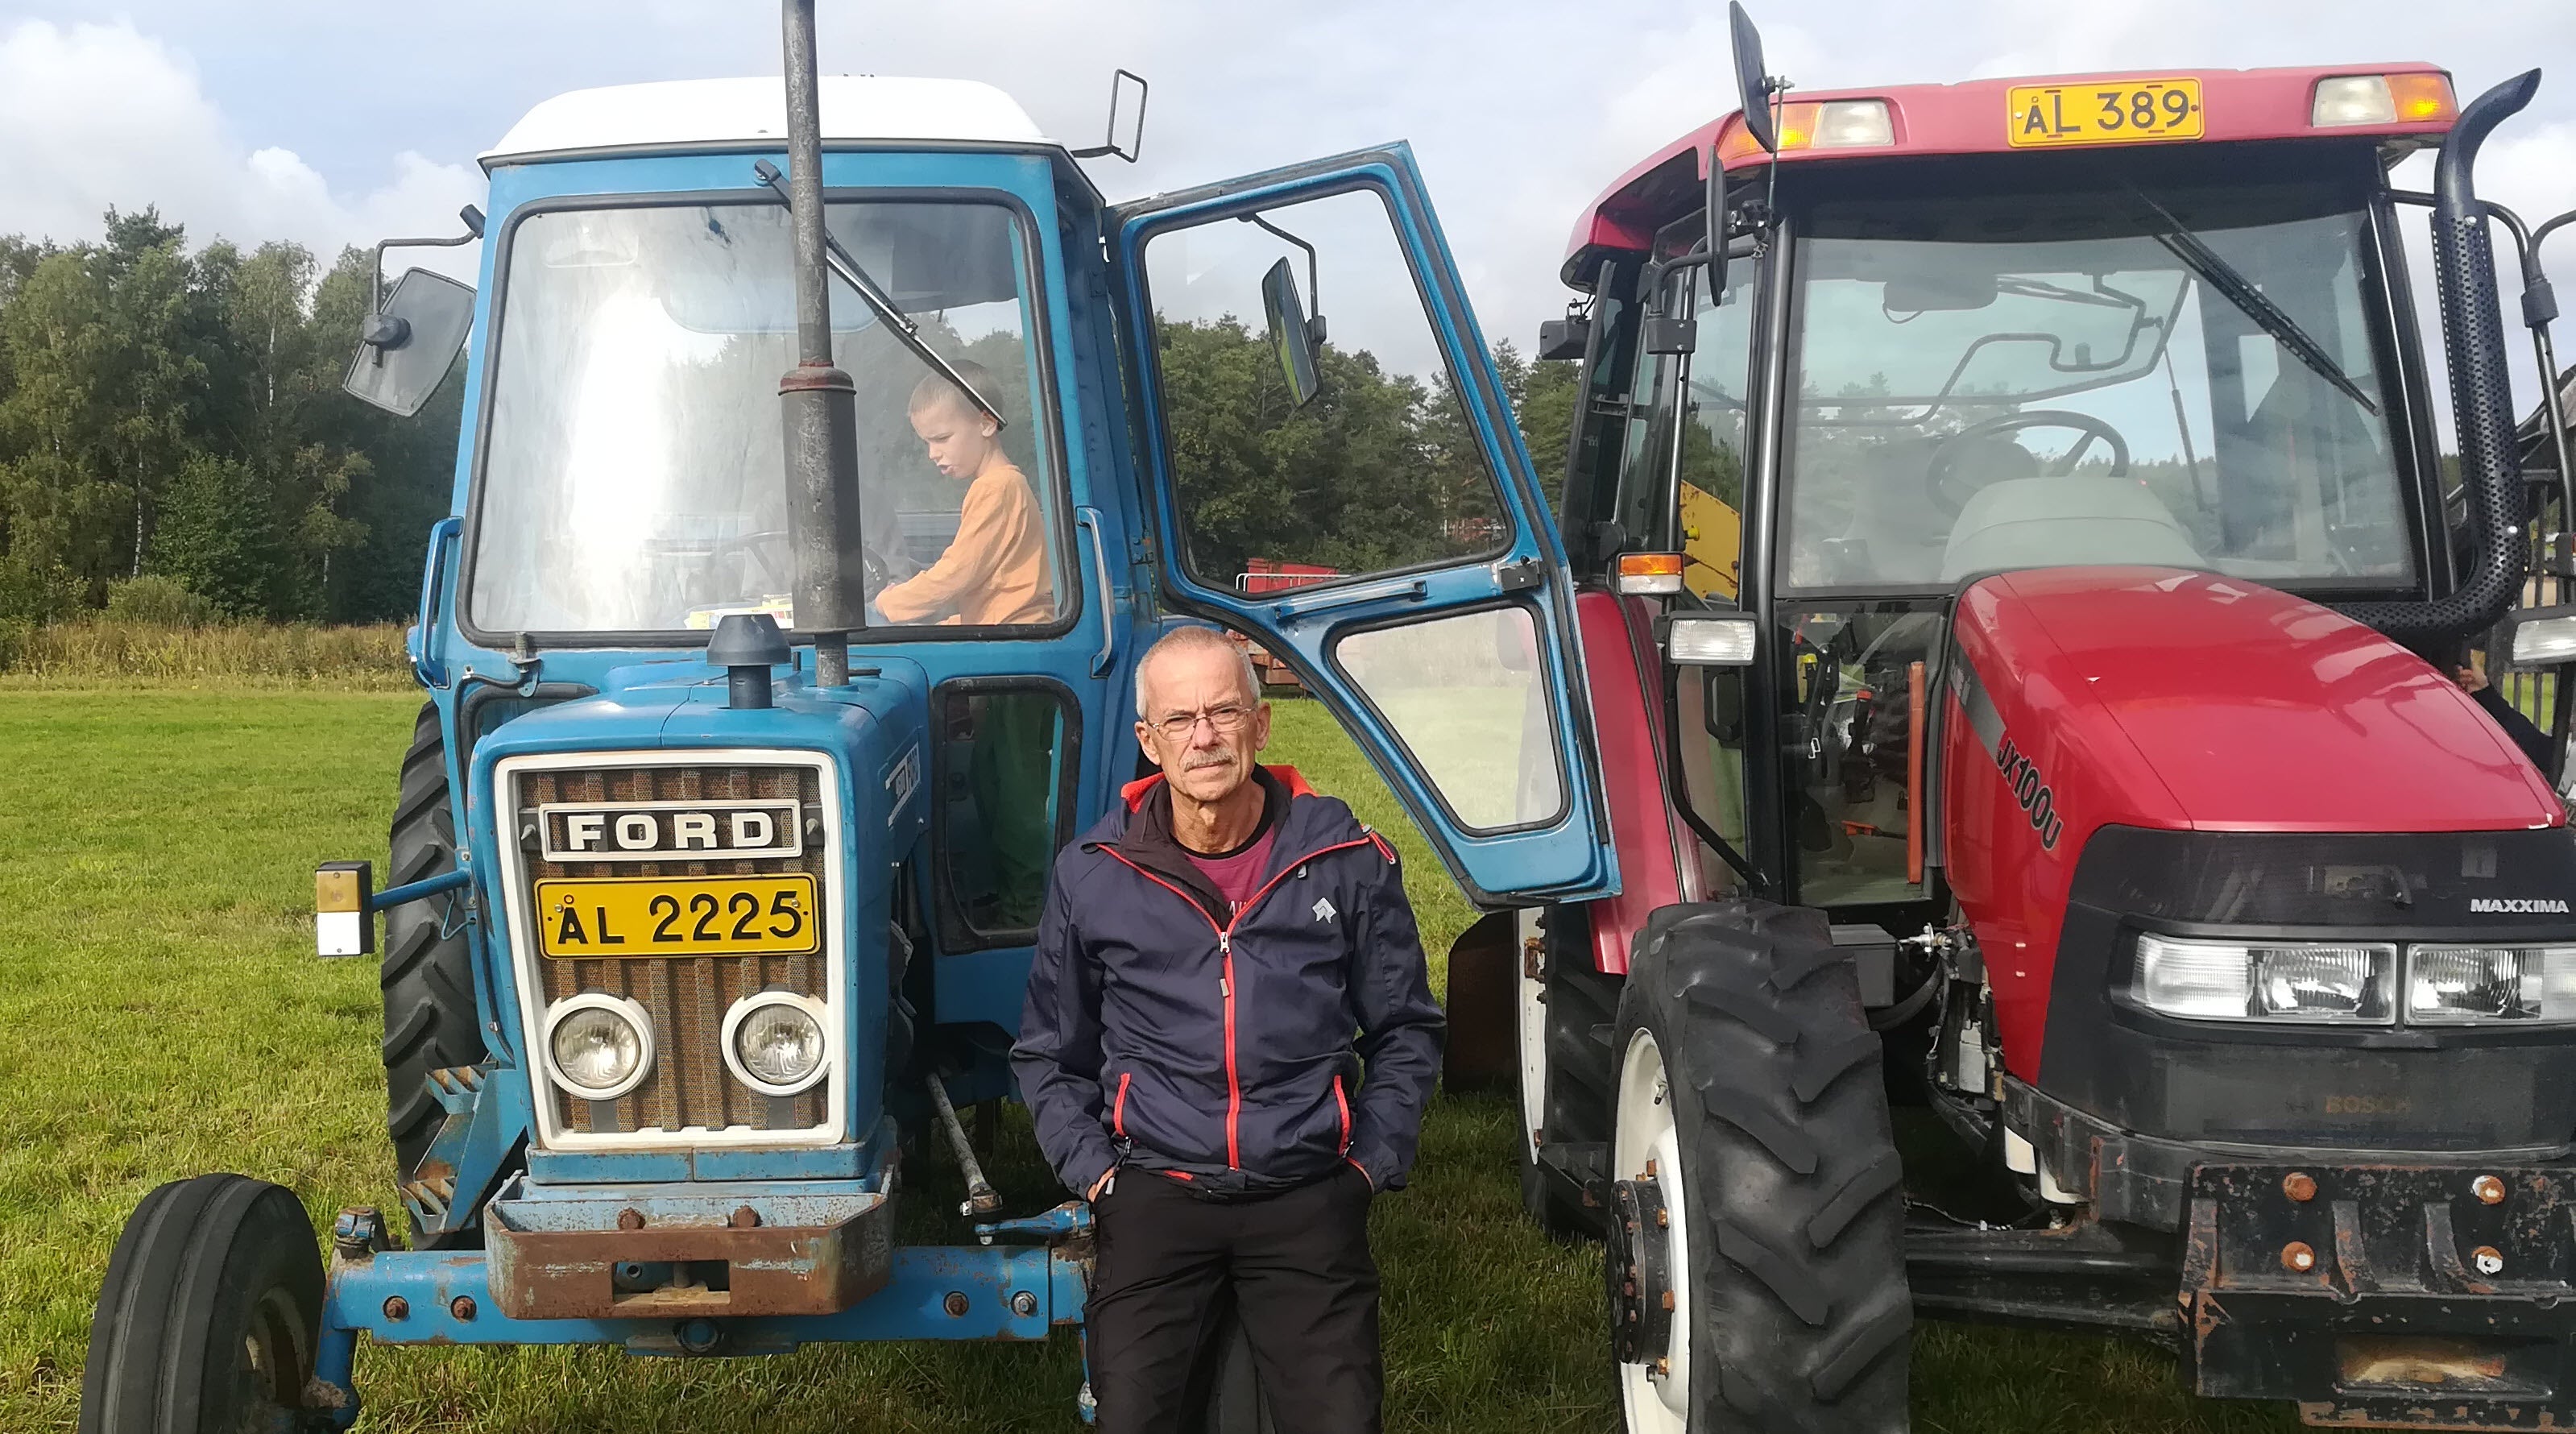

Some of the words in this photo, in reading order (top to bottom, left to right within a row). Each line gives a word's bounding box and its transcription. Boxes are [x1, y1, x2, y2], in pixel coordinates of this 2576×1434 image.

[2023, 95, 2081, 134] ÅL
[2097, 89, 2189, 131] 389
[1997, 738, 2064, 852] JX100U
[567, 812, 774, 851] FORD
[557, 894, 625, 944] ÅL
[649, 890, 802, 943] 2225
[2470, 898, 2570, 913] MAXXIMA
